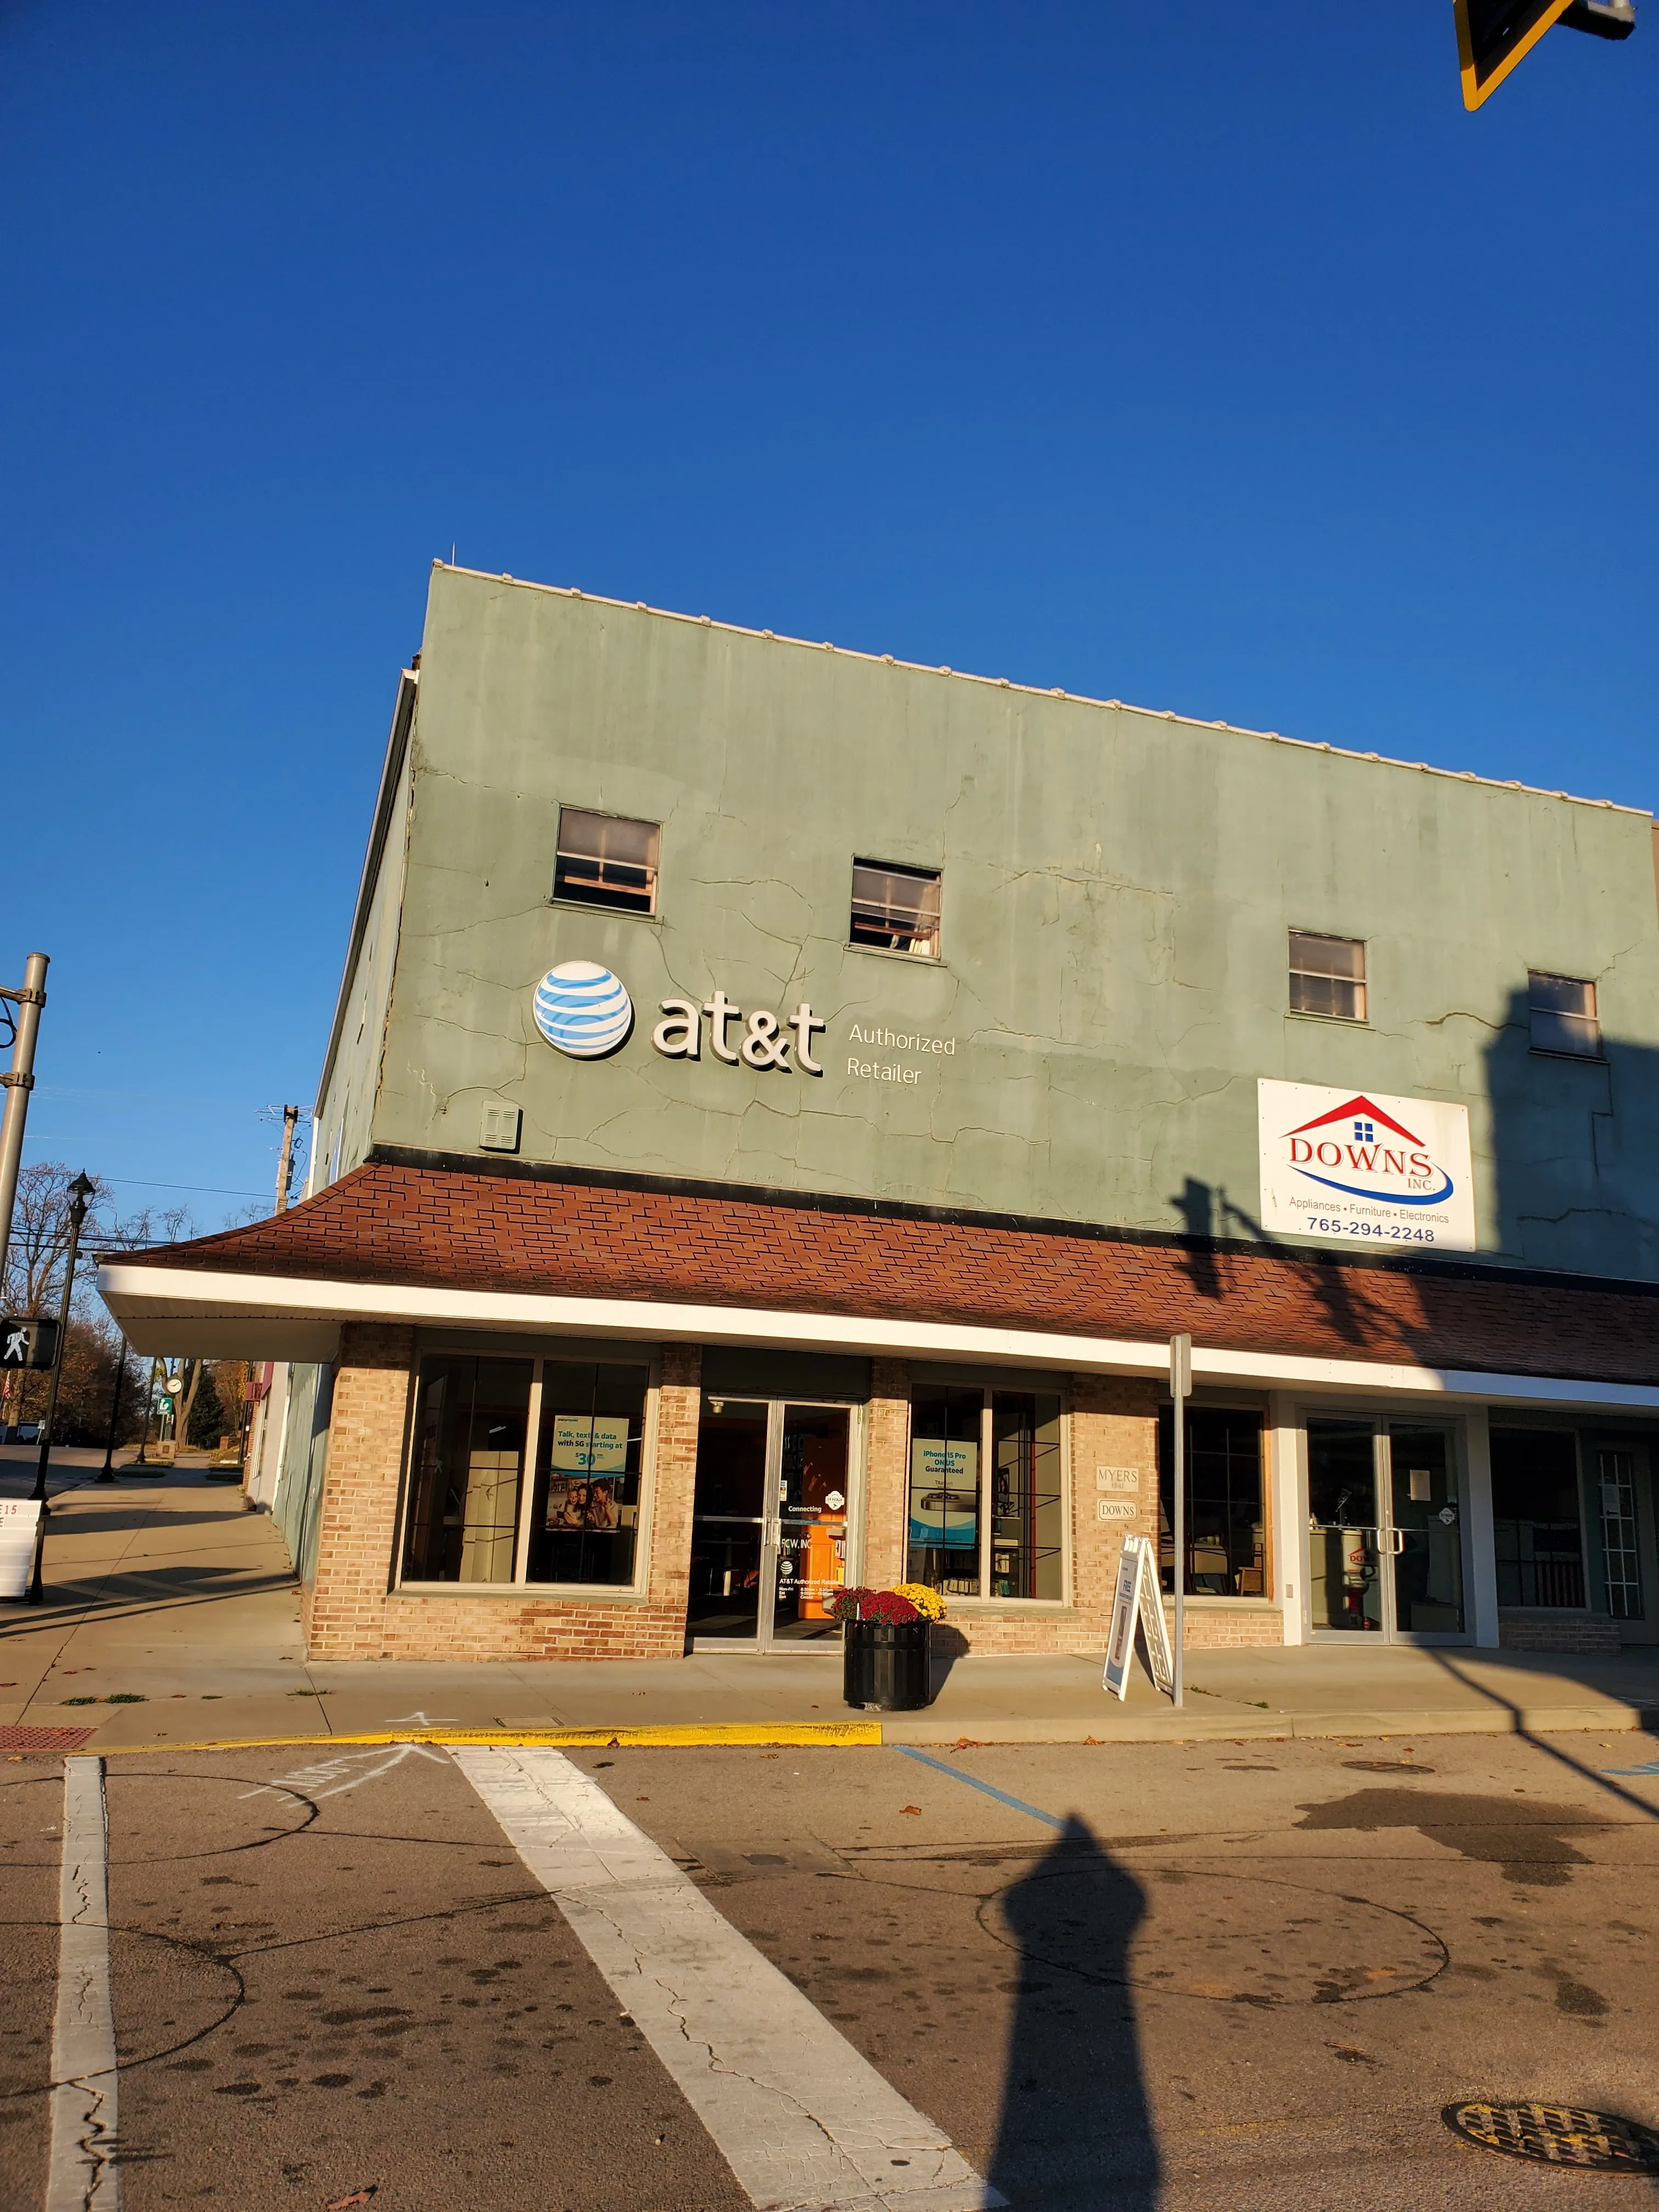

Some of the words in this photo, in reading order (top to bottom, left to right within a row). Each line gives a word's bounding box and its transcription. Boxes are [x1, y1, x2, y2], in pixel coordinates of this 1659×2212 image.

[651, 990, 825, 1075] at&t
[848, 1024, 956, 1057] Authorized
[847, 1059, 922, 1085] Retailer
[1289, 1137, 1434, 1179] DOWNS
[1407, 1178, 1436, 1191] INC.
[1289, 1197, 1341, 1212] Appliances
[1350, 1204, 1391, 1217] Furniture
[1400, 1210, 1449, 1223] Electronics
[1307, 1217, 1435, 1242] 765-294-2248
[575, 1453, 596, 1465] $30
[1099, 1469, 1137, 1482] MYERS
[1102, 1505, 1134, 1516] DOWNS
